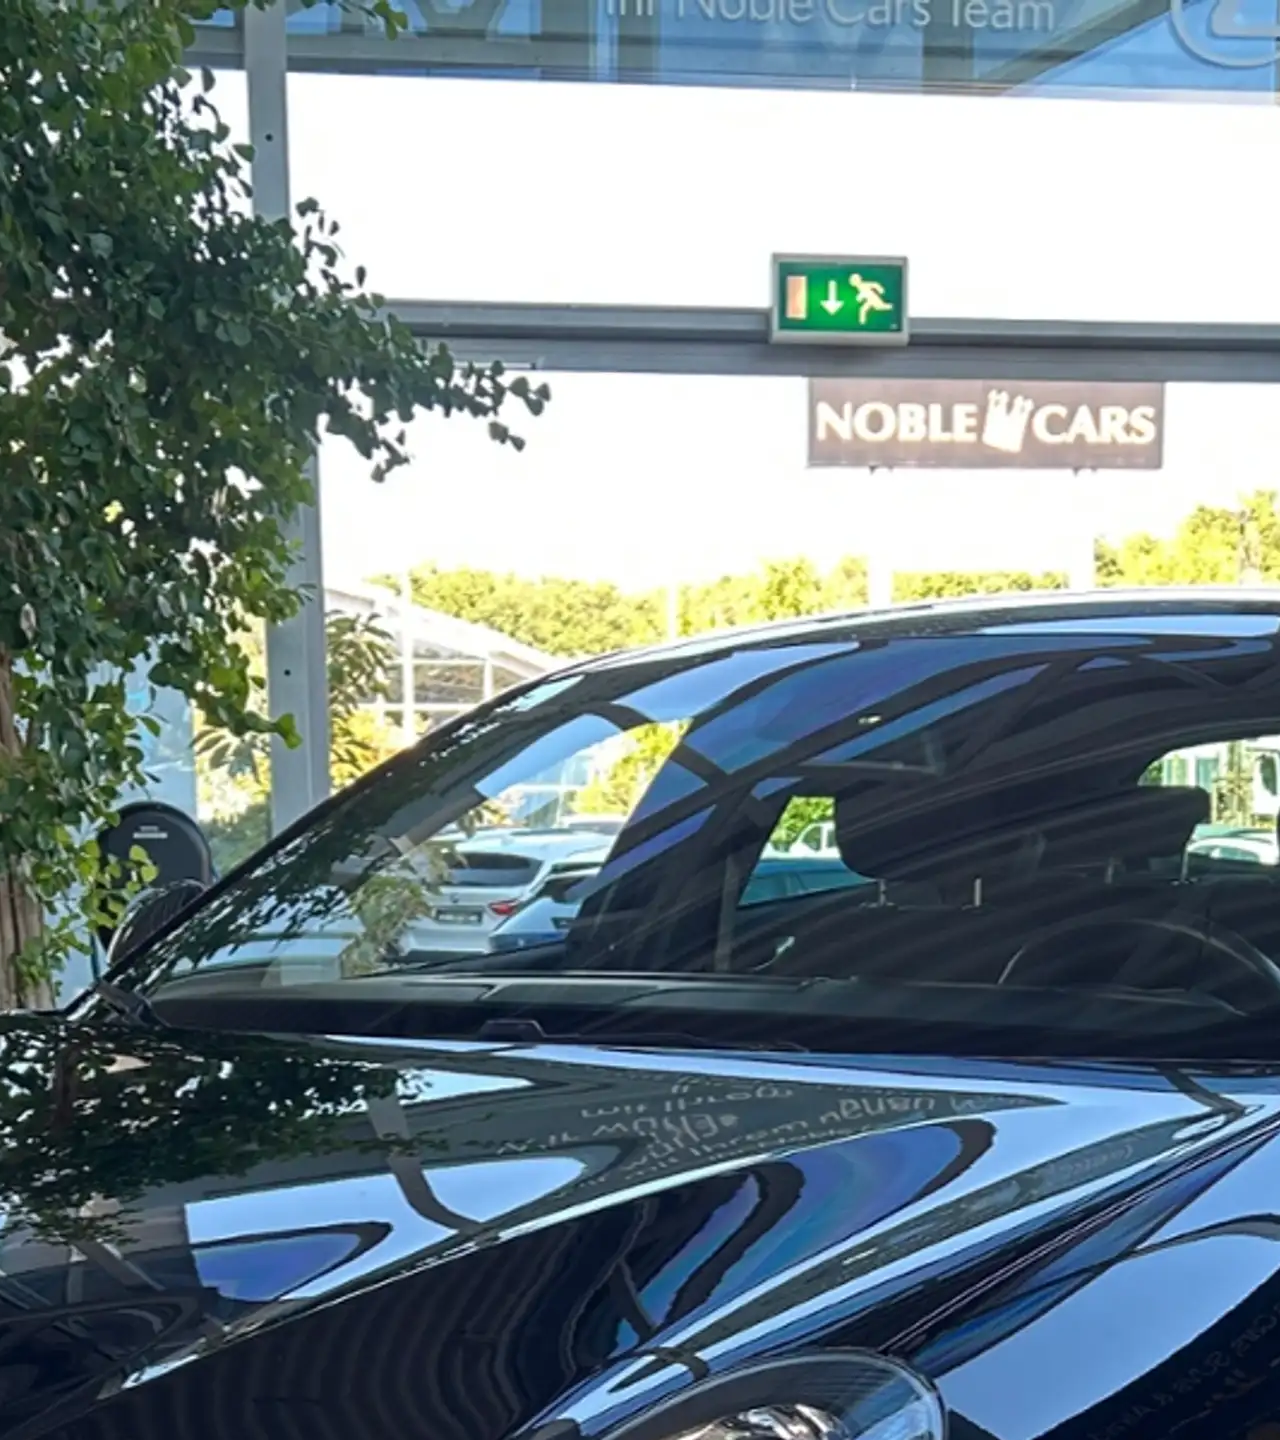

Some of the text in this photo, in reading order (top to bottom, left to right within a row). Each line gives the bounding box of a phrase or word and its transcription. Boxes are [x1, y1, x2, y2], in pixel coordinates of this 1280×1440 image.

[677, 0, 813, 24] Noble
[827, 0, 931, 27] Cars
[952, 1, 1055, 32] Team
[816, 401, 1158, 445] NOBLE CARS
